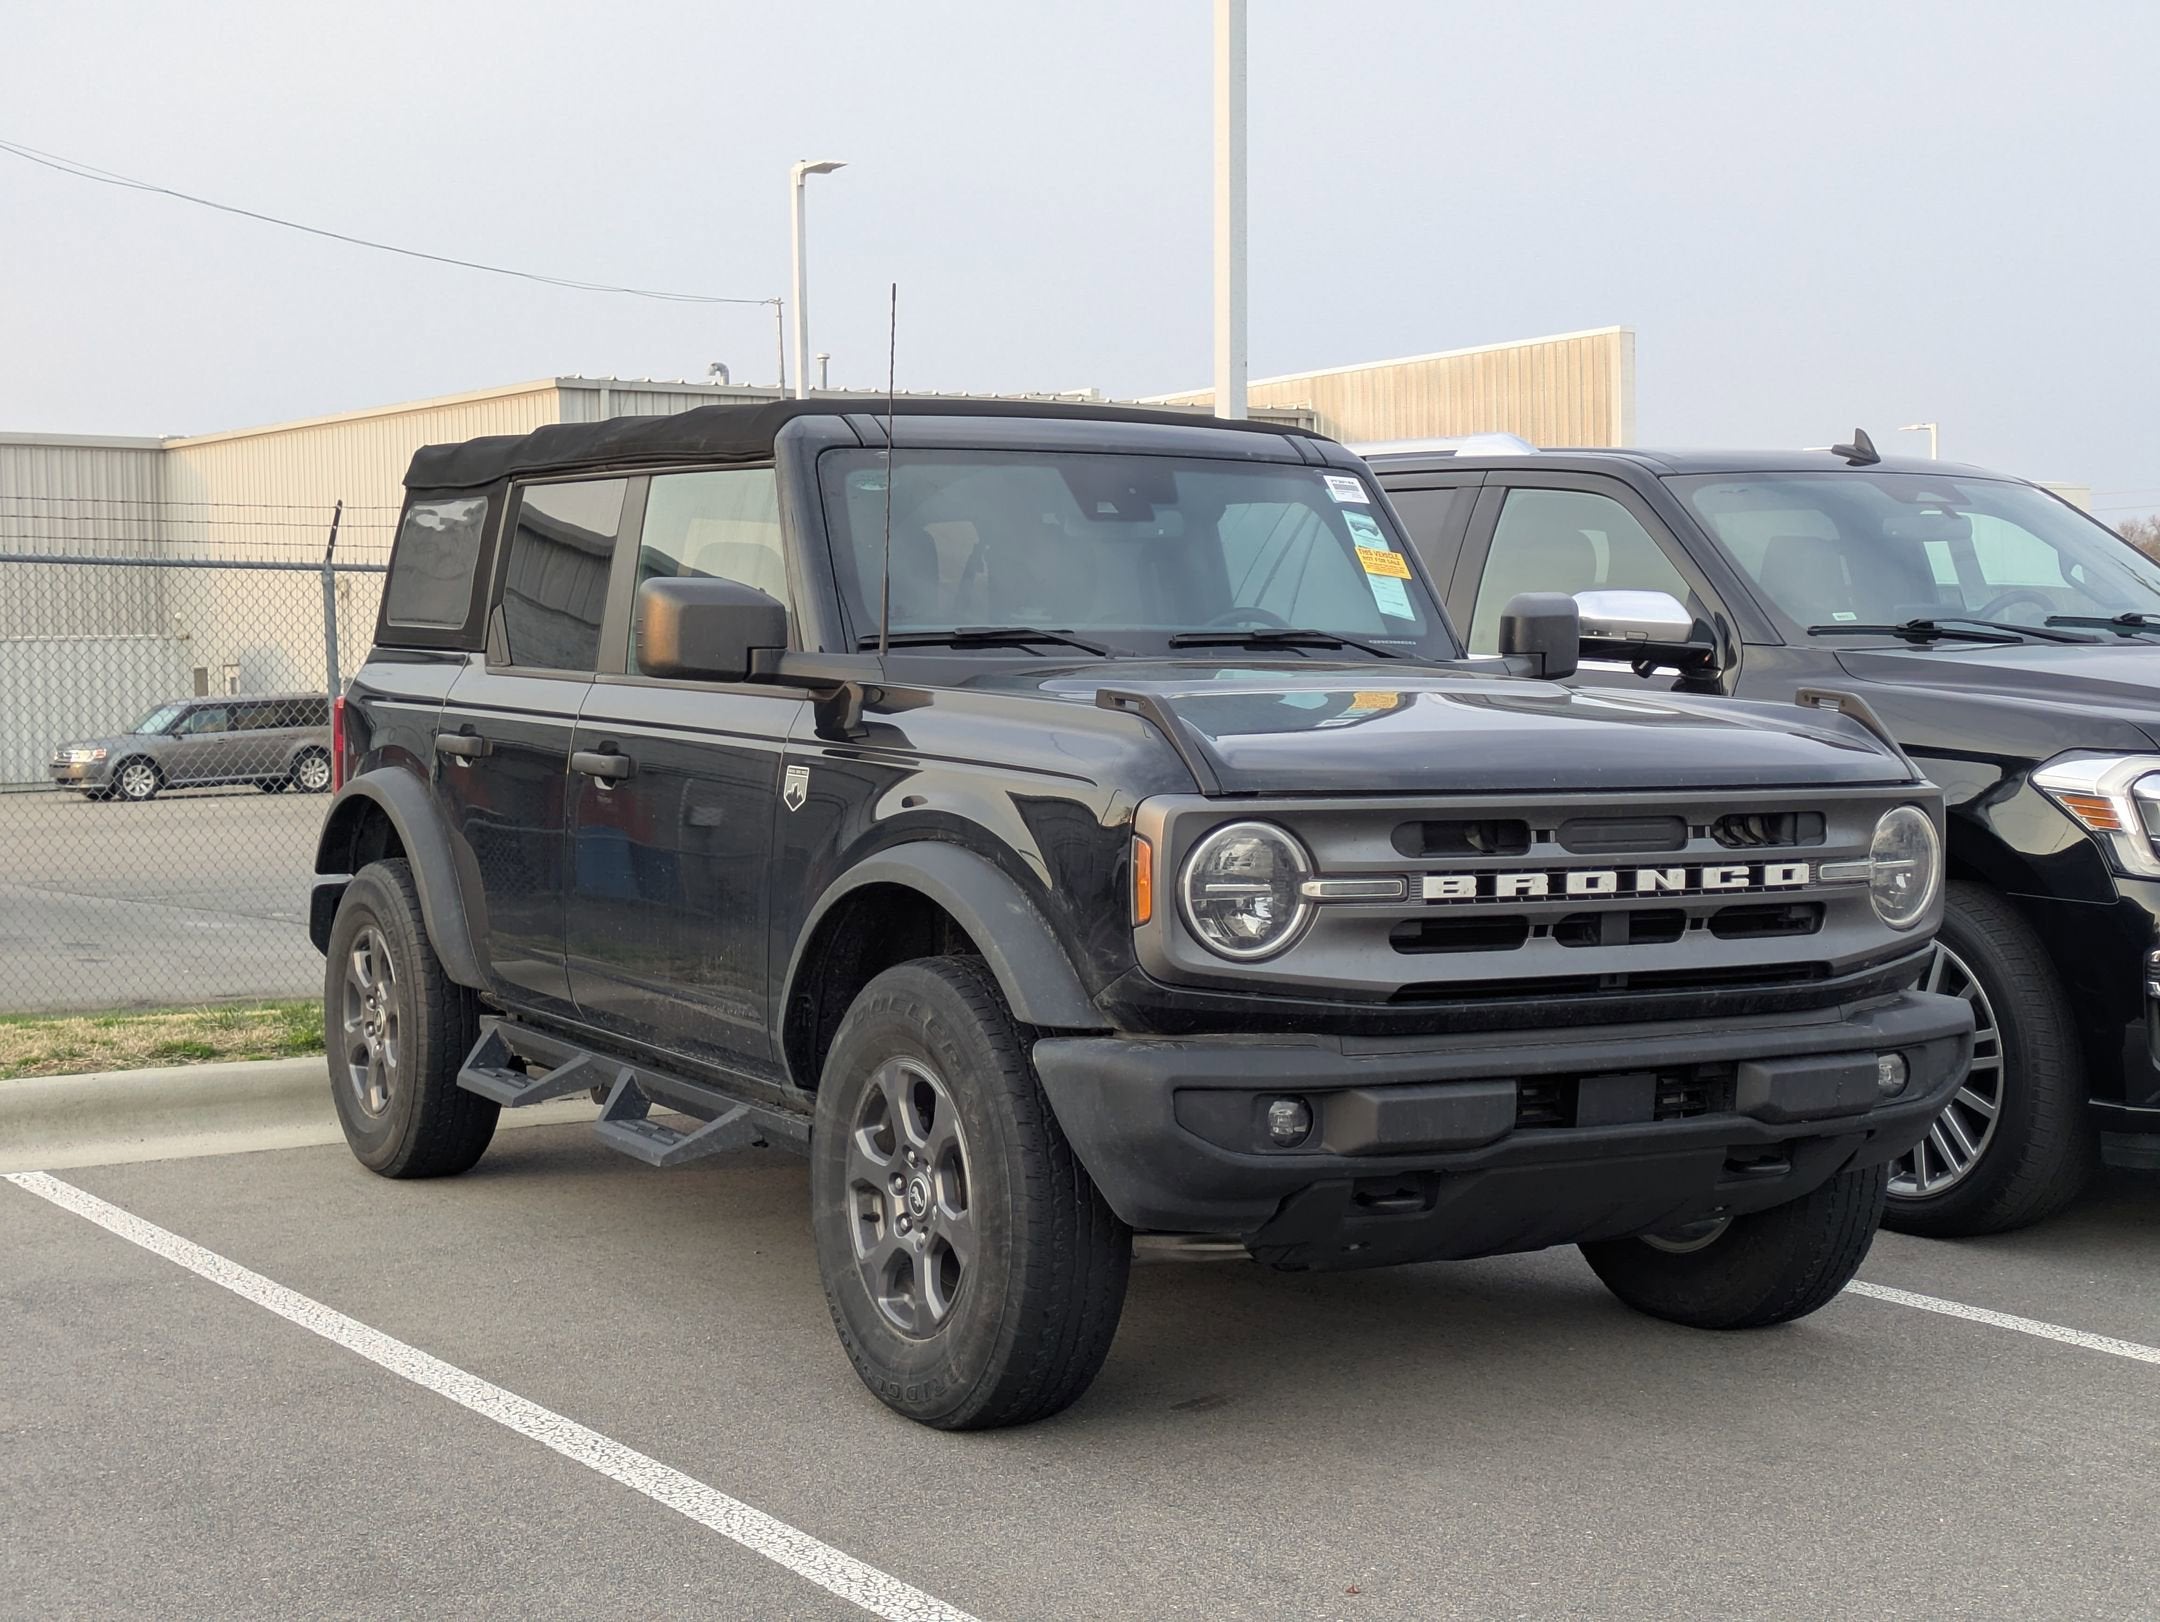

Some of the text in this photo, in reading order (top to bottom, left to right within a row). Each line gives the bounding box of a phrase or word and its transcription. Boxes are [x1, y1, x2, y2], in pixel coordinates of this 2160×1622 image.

[1358, 548, 1402, 561] THIS VEHICLE
[1422, 863, 1810, 898] BRONCO
[852, 992, 963, 1072] DUELER
